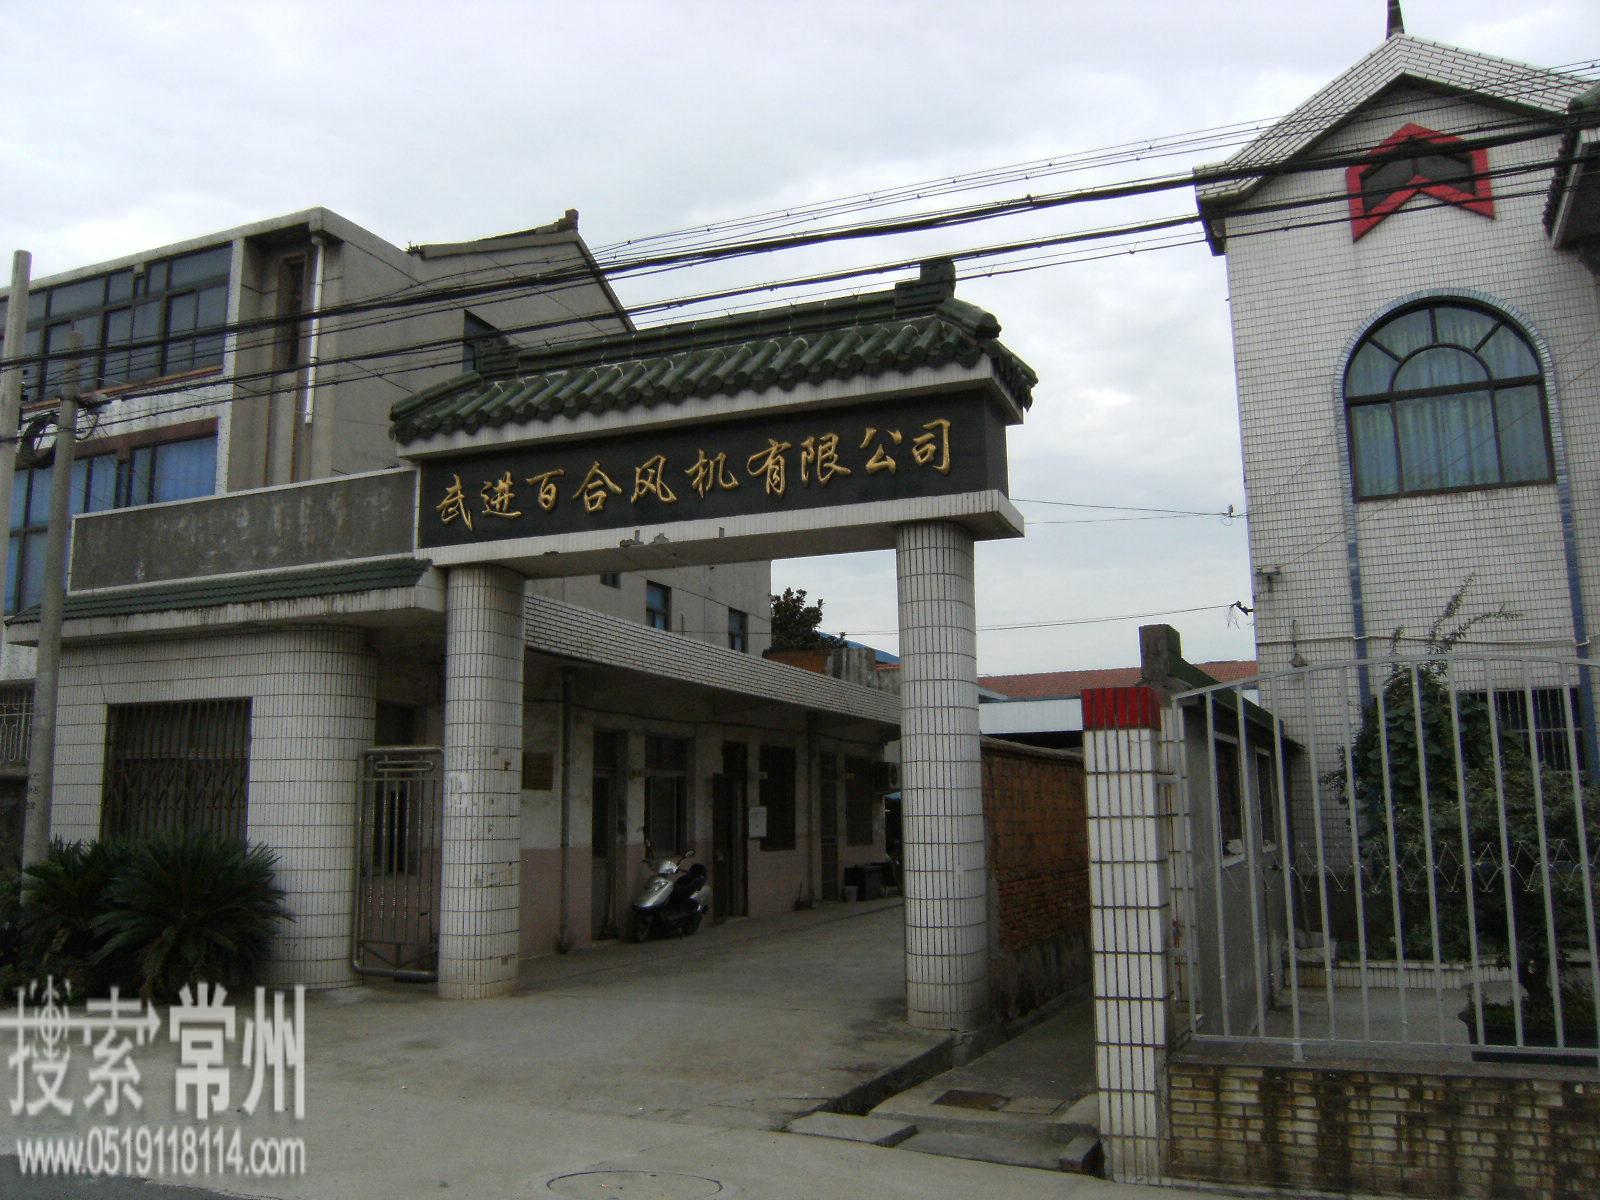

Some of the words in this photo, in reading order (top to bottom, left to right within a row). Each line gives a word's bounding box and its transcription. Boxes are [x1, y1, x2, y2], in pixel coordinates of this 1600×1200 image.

[436, 419, 952, 530] 武进百合风机有限公司
